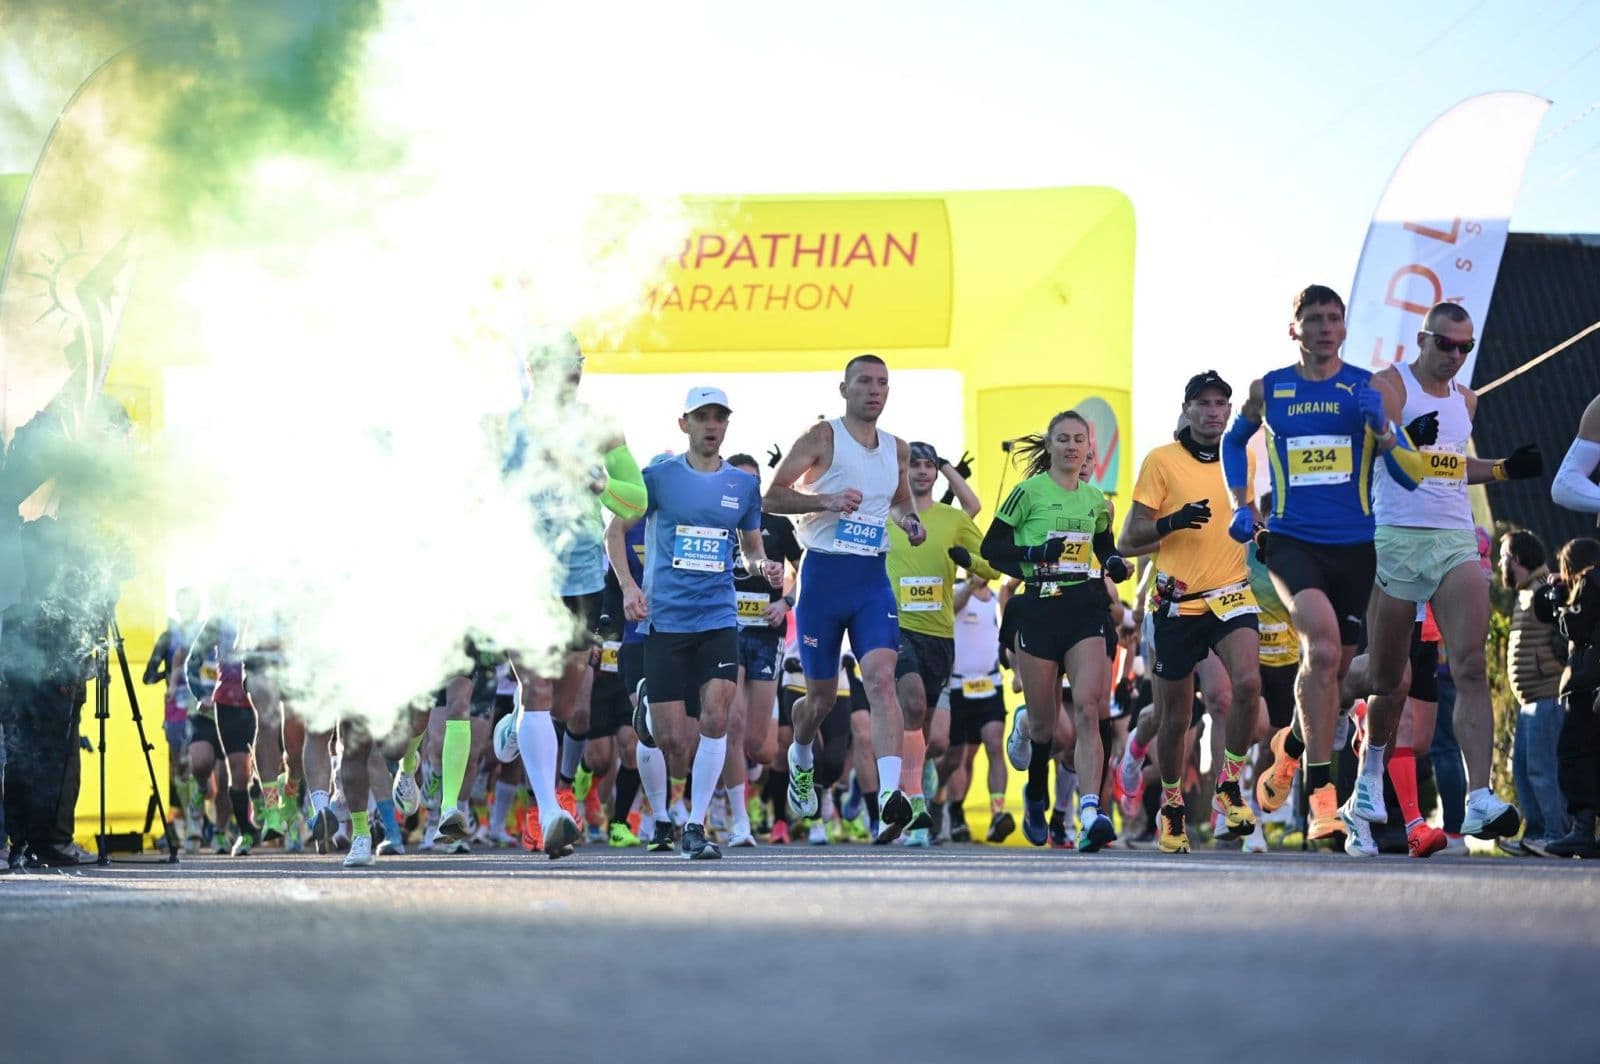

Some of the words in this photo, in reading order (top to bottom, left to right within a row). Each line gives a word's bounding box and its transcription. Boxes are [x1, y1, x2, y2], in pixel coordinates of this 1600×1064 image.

[1287, 402, 1341, 416] UKRAINE
[1302, 449, 1337, 464] 234
[1431, 455, 1458, 469] 040
[843, 523, 878, 539] 2046
[681, 537, 720, 554] 2152
[910, 586, 933, 597] 064
[737, 601, 759, 612] 073
[1219, 592, 1246, 607] 222
